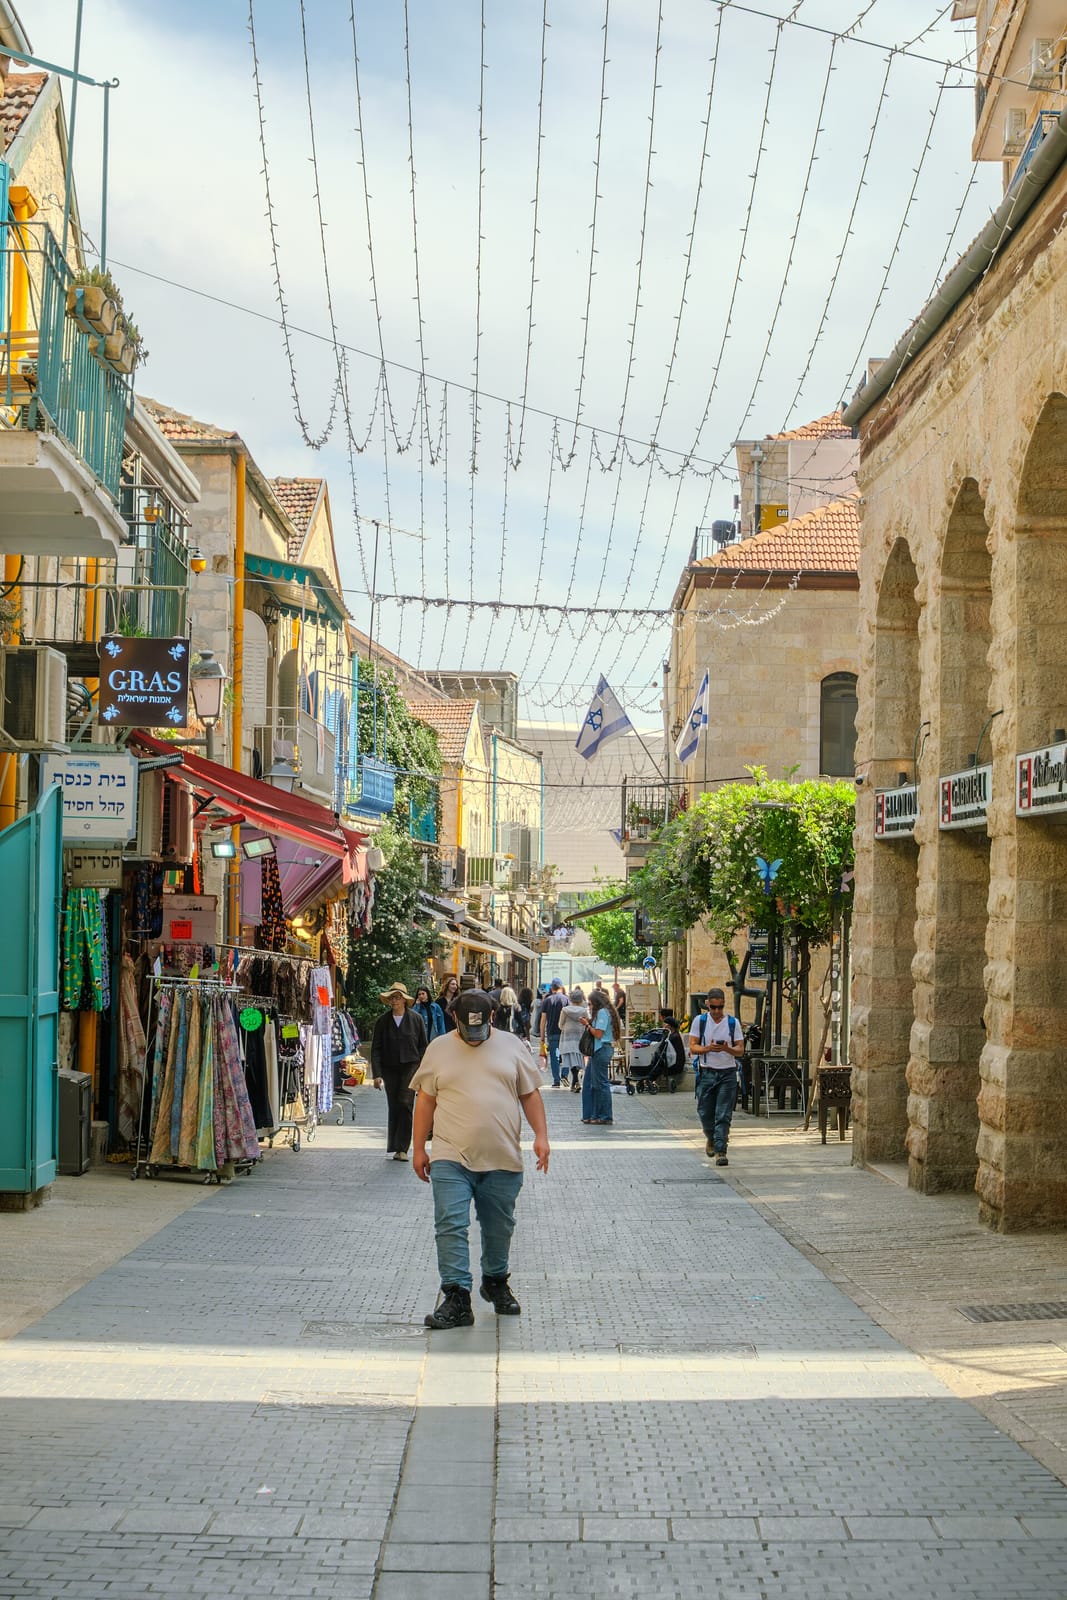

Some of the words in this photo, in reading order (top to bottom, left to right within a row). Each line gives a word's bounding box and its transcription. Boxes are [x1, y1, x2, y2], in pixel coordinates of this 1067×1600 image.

[778, 509, 788, 517] CAT
[117, 693, 148, 703] ישראלית
[149, 695, 172, 704] אמנות
[52, 772, 92, 787] כנסת
[97, 773, 127, 788] בית
[63, 799, 94, 811] חסיד
[98, 795, 125, 816] קהל
[73, 854, 121, 870] חסידים
